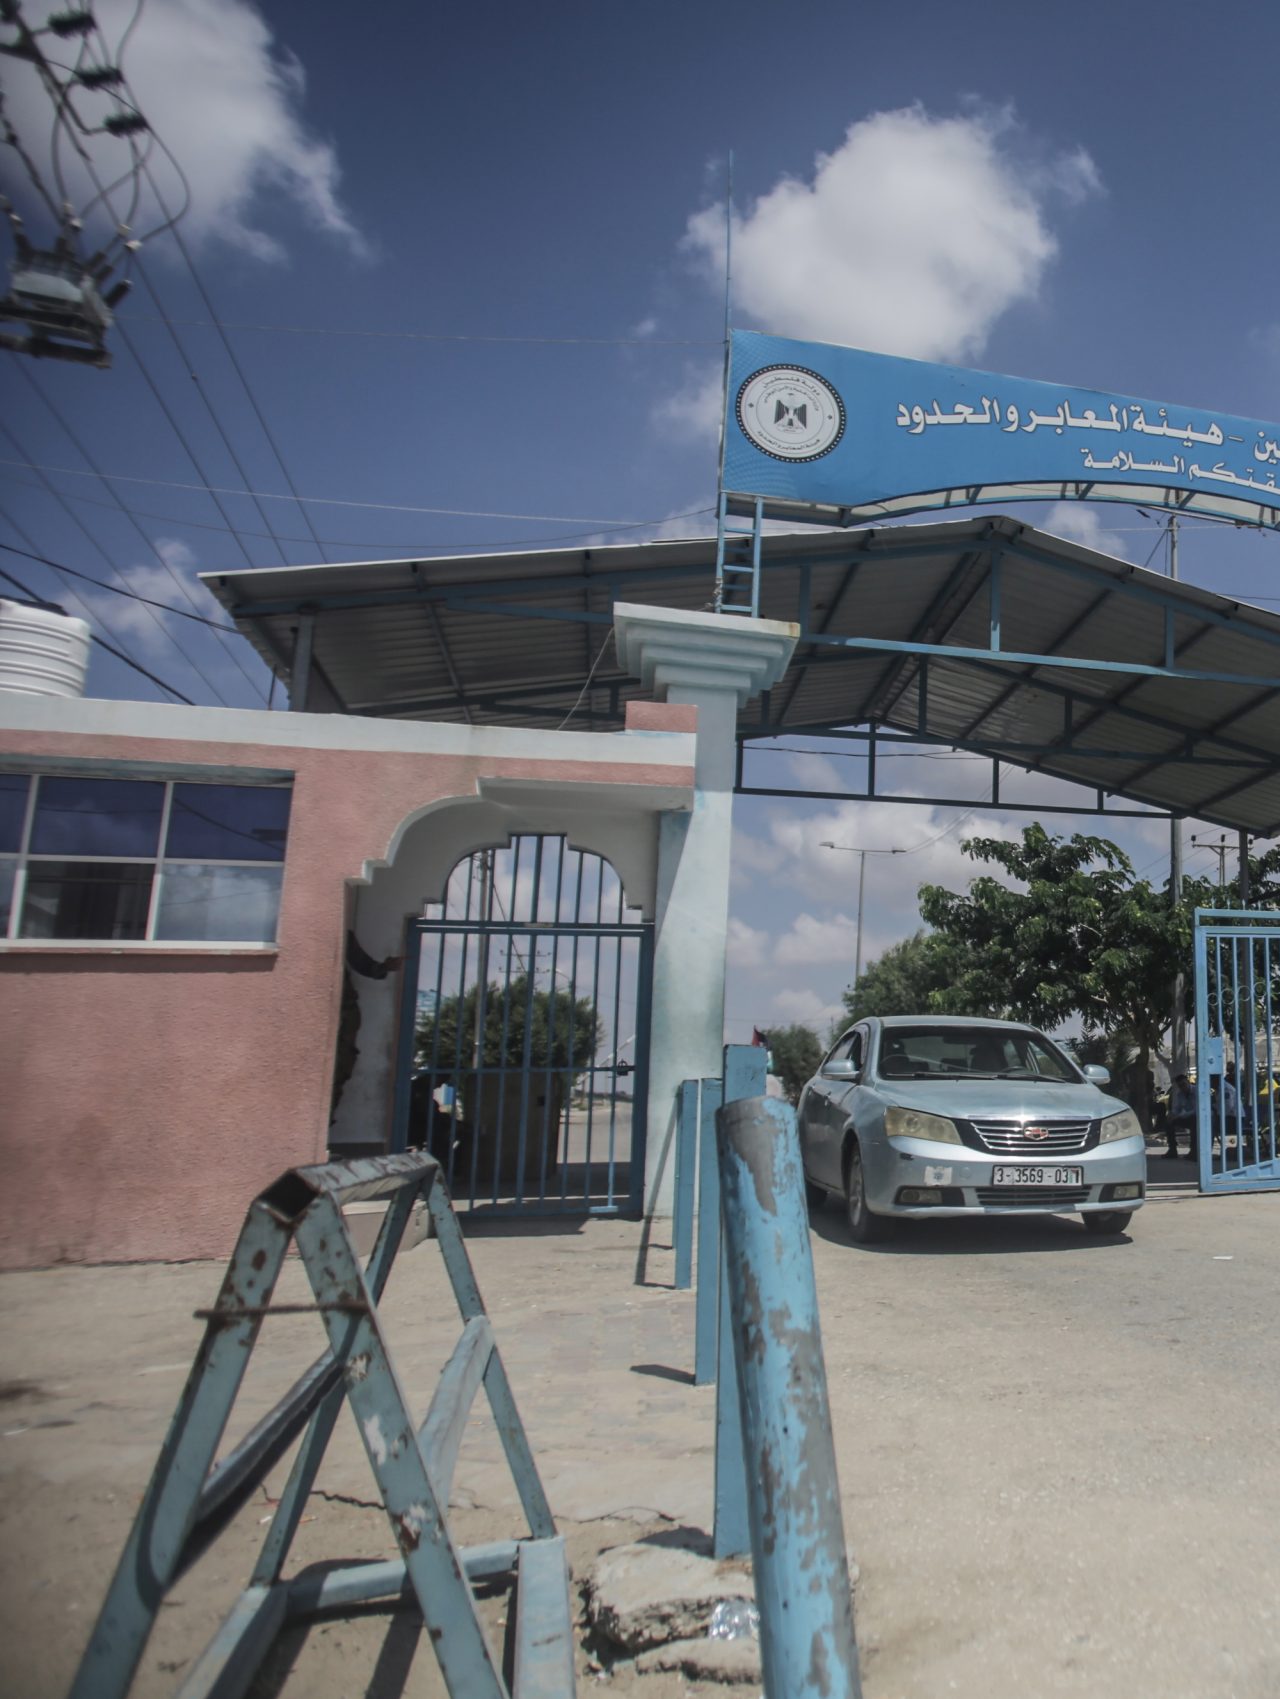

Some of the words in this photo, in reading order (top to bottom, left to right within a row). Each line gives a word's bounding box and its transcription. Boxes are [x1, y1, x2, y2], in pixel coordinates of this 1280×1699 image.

[1020, 400, 1129, 435] المعابر
[1129, 404, 1225, 447] هيئة
[1080, 448, 1185, 474] السلامة
